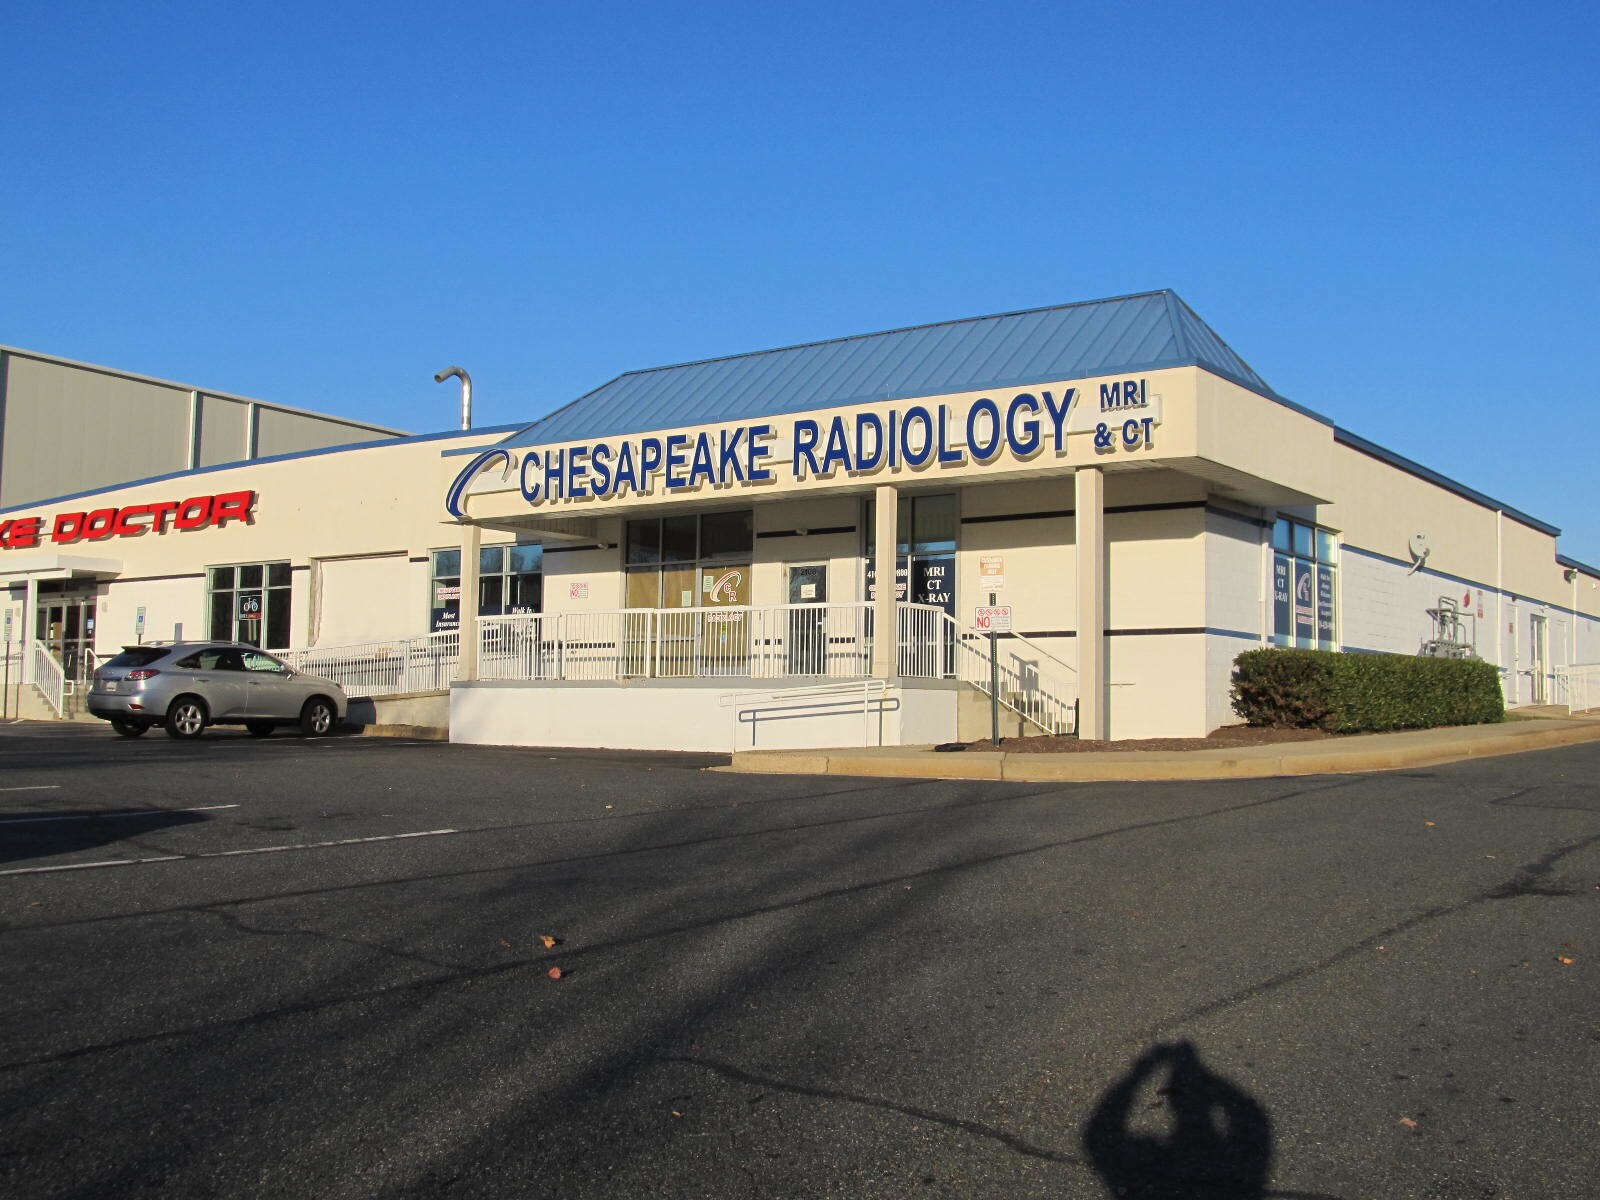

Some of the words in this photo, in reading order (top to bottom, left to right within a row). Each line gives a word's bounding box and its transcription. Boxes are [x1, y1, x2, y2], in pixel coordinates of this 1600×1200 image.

[1099, 378, 1147, 410] MRI
[1094, 422, 1113, 448] &
[1122, 417, 1154, 445] CT
[520, 424, 771, 503] CHESAPEAKE
[792, 387, 1077, 476] RADIOLOGY
[51, 490, 253, 543] DOCTOR
[923, 566, 945, 577] MRI
[926, 579, 942, 590] CT
[917, 592, 951, 604] X-RAY
[442, 611, 456, 620] Most
[435, 620, 460, 628] Insuranc
[976, 616, 991, 628] NO
